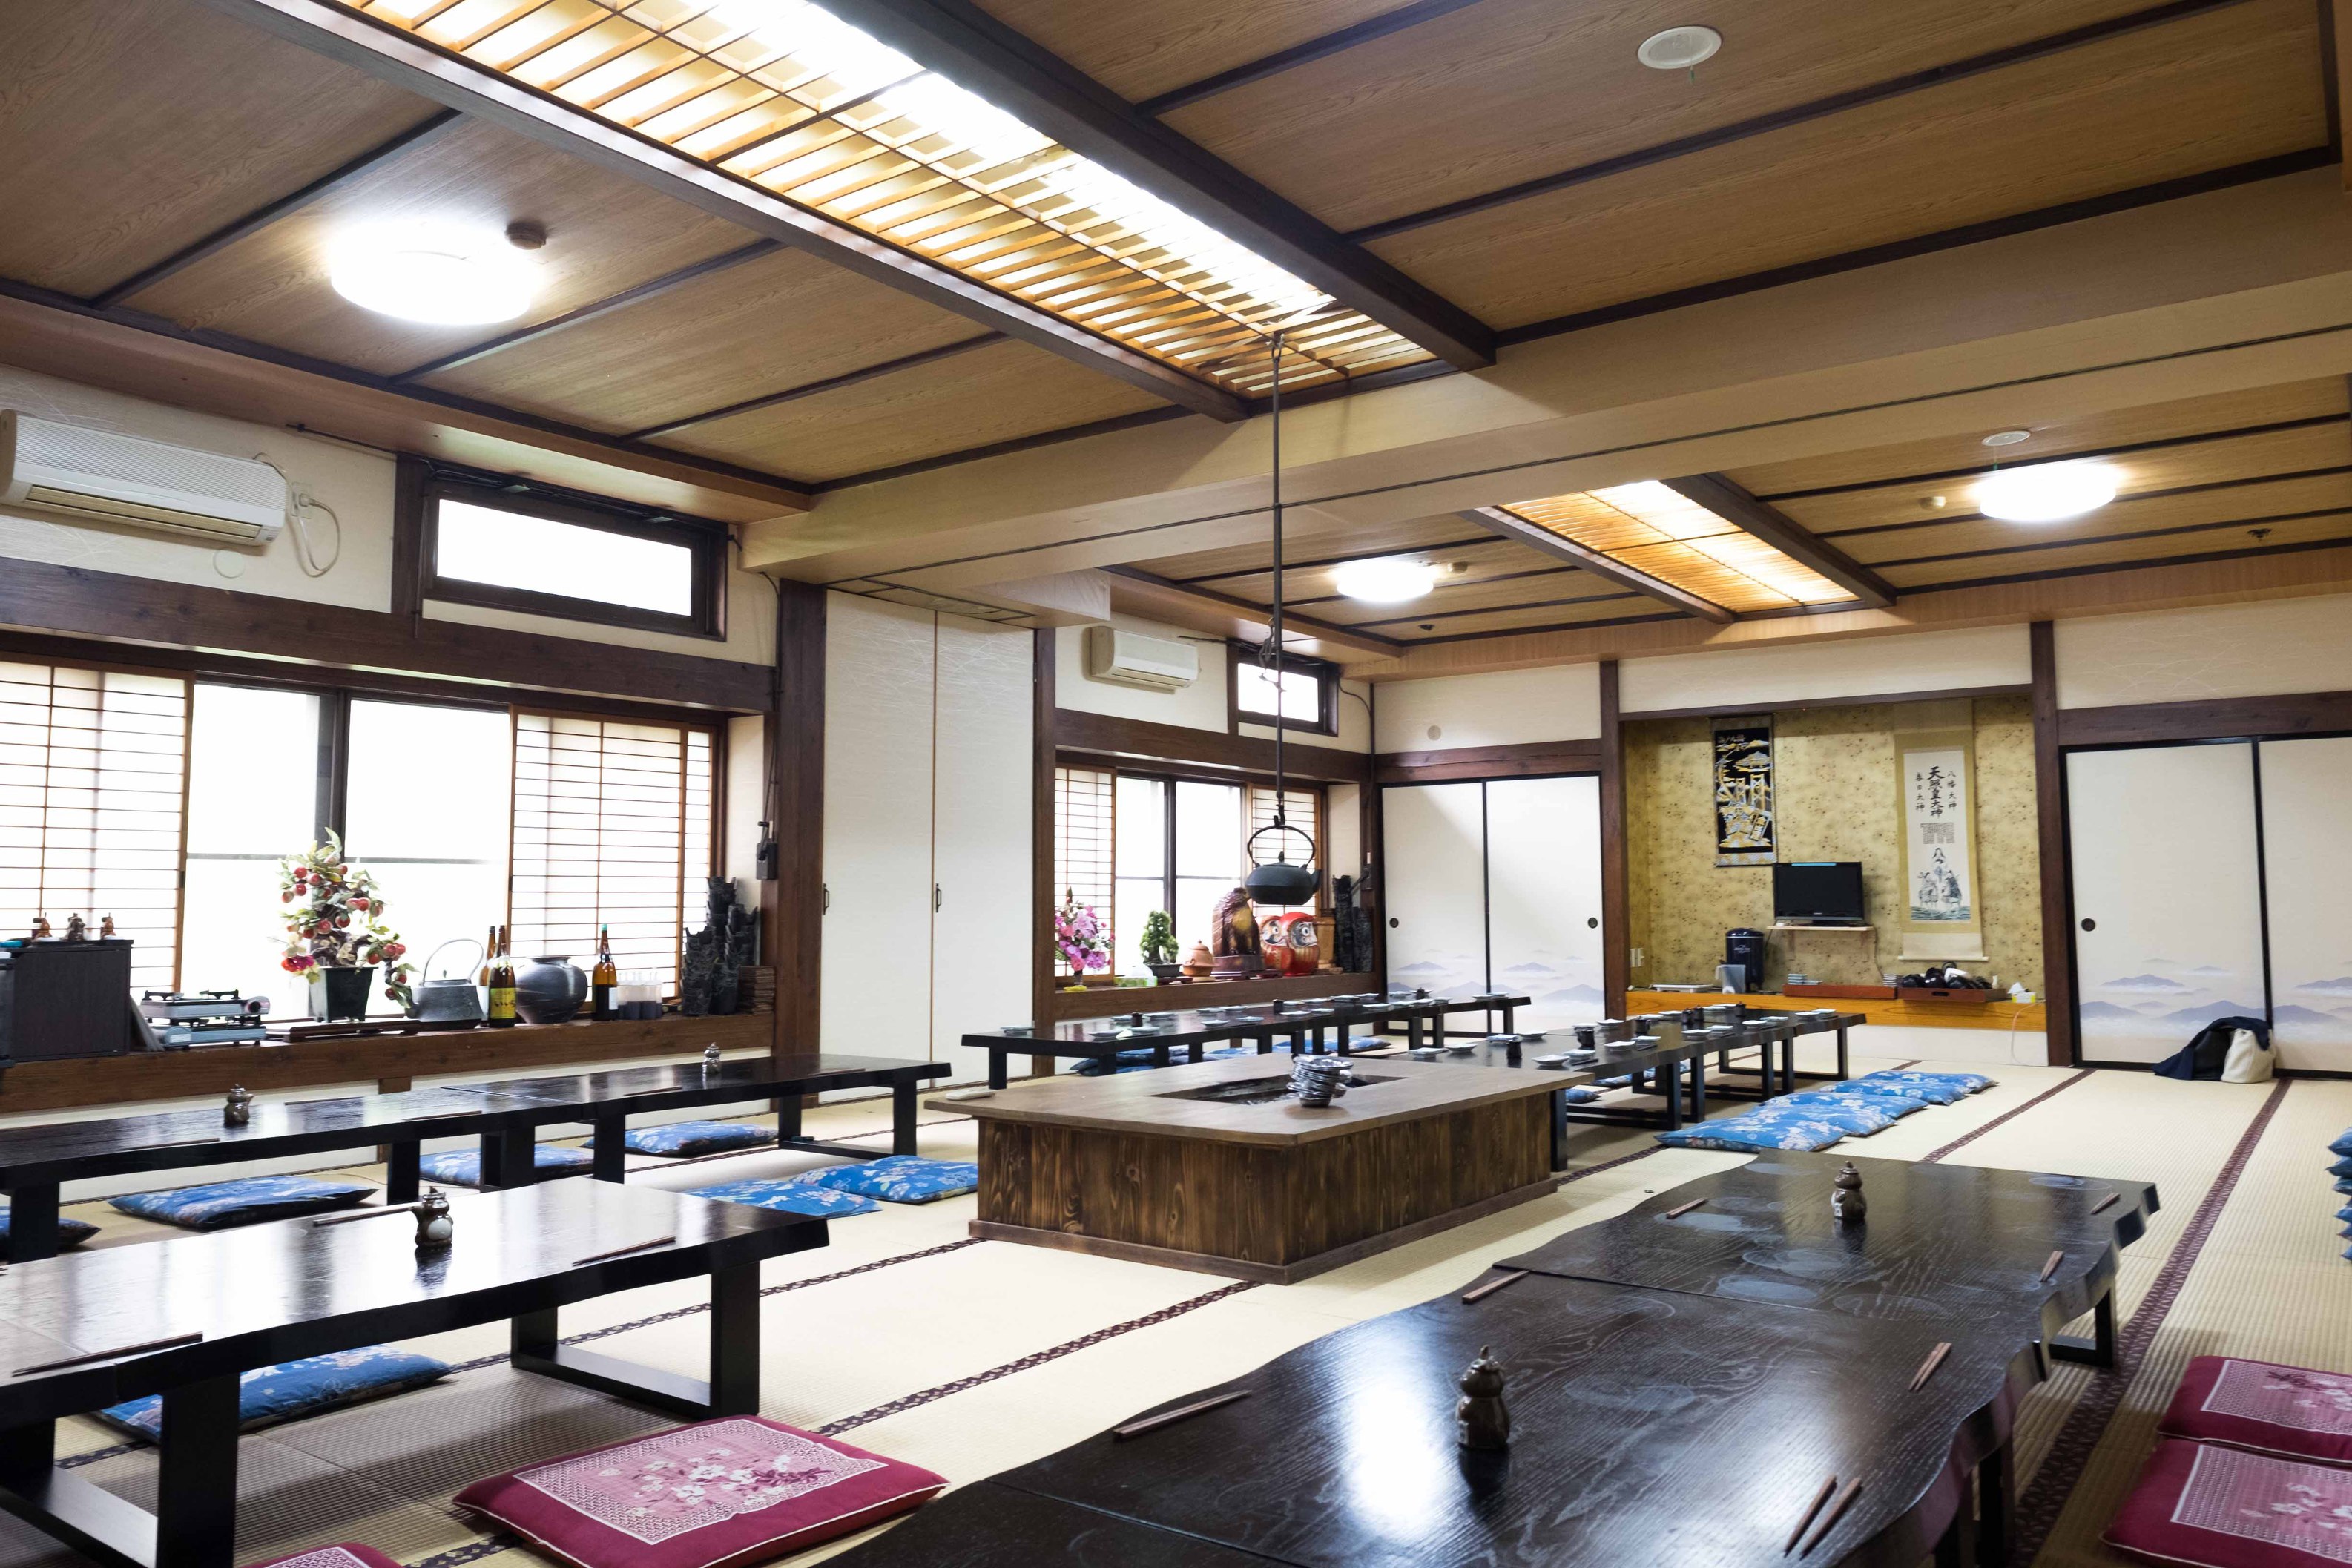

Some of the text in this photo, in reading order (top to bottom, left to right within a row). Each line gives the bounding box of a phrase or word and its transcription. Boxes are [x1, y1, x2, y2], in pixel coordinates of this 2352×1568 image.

[1915, 772, 1926, 812] 春日大神
[1927, 765, 1945, 819] 天照皇大神
